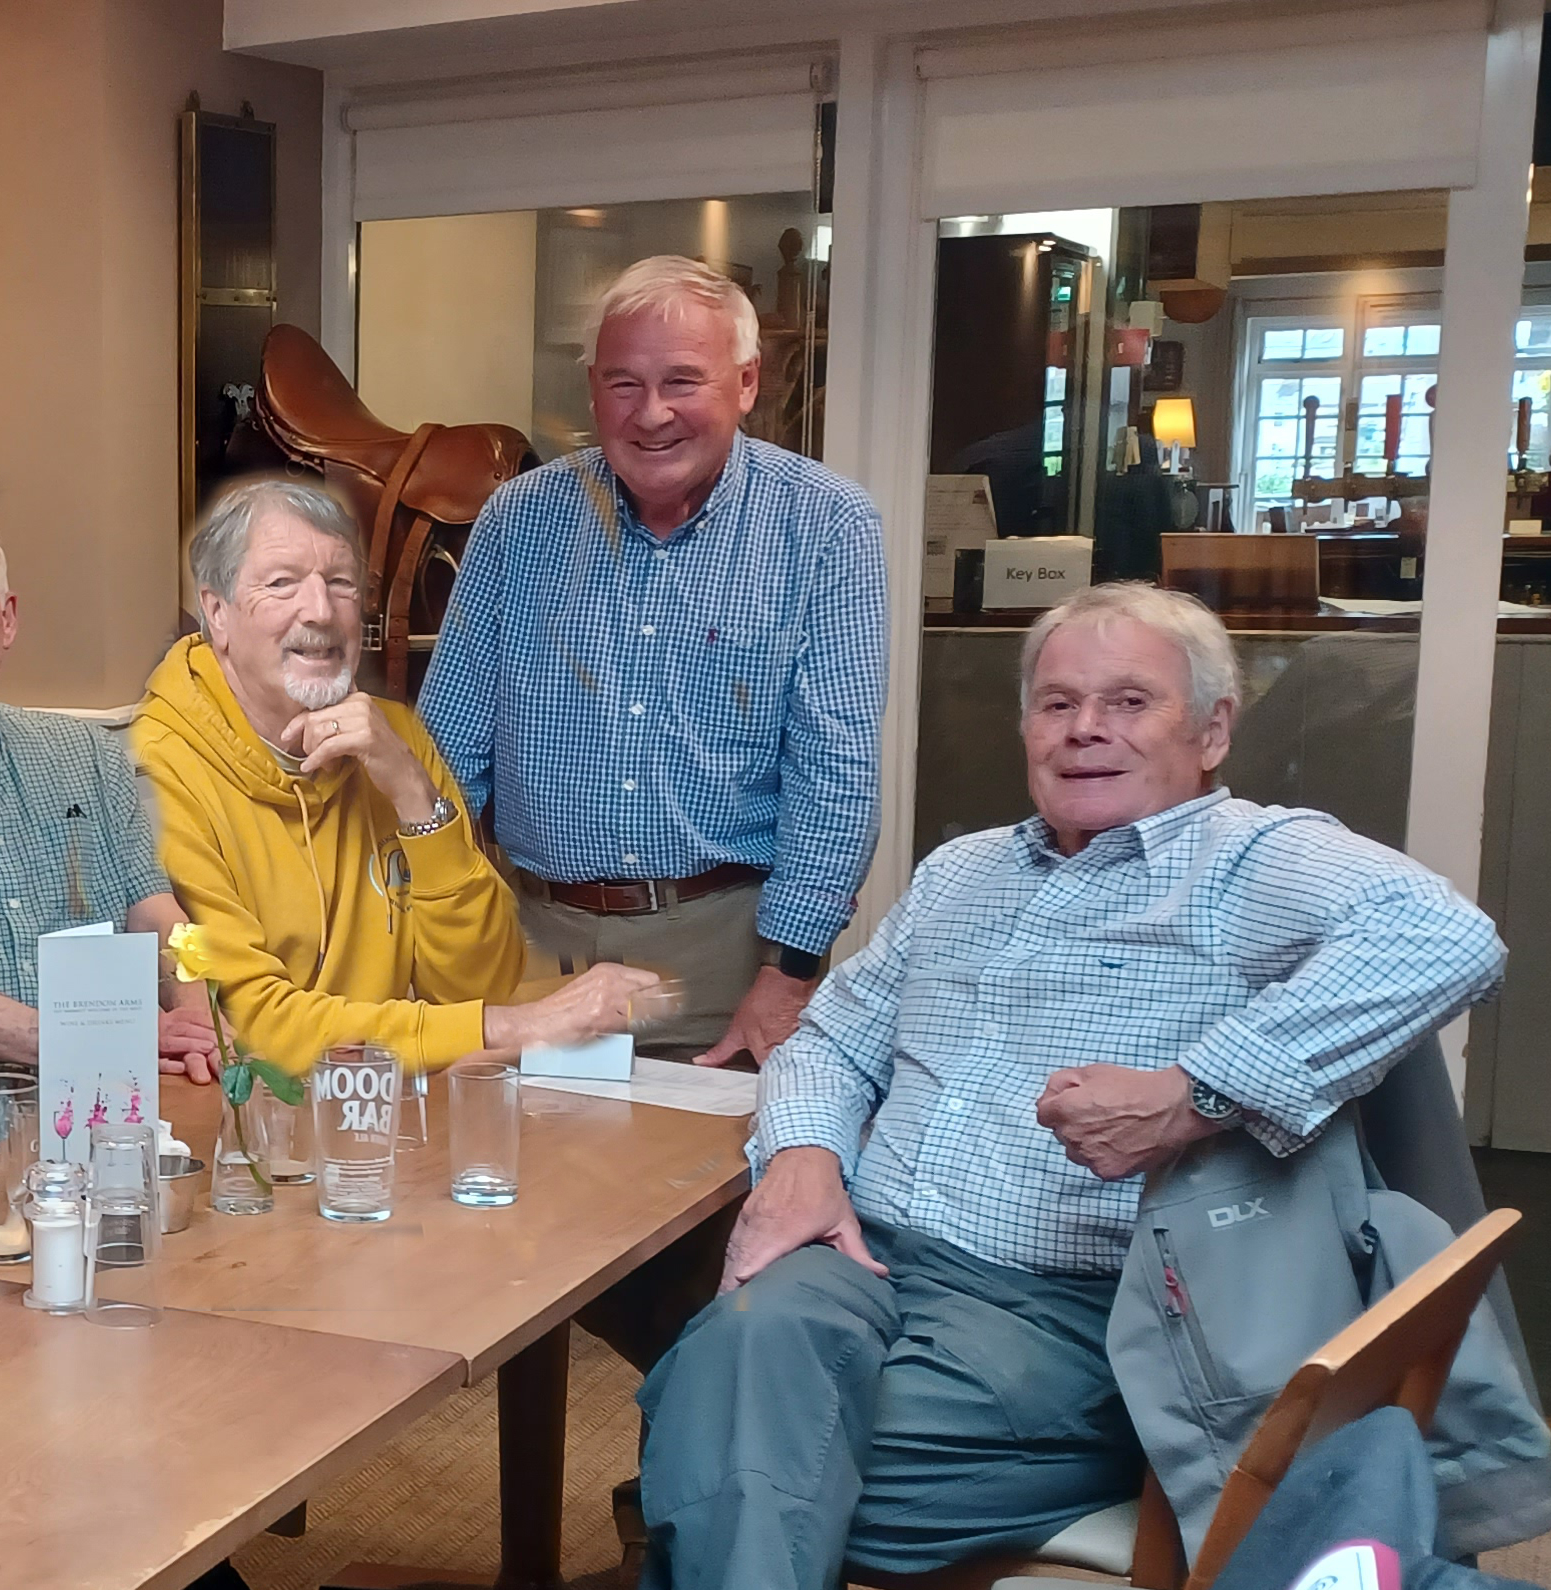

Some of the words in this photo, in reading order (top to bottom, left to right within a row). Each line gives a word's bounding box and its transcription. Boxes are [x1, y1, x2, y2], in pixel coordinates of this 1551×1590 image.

[1005, 567, 1033, 583] Key
[1037, 567, 1066, 580] Box
[53, 1001, 70, 1009] THE
[73, 999, 117, 1008] BRENDON
[119, 998, 143, 1006] ARMS
[1207, 1196, 1270, 1228] DLX
